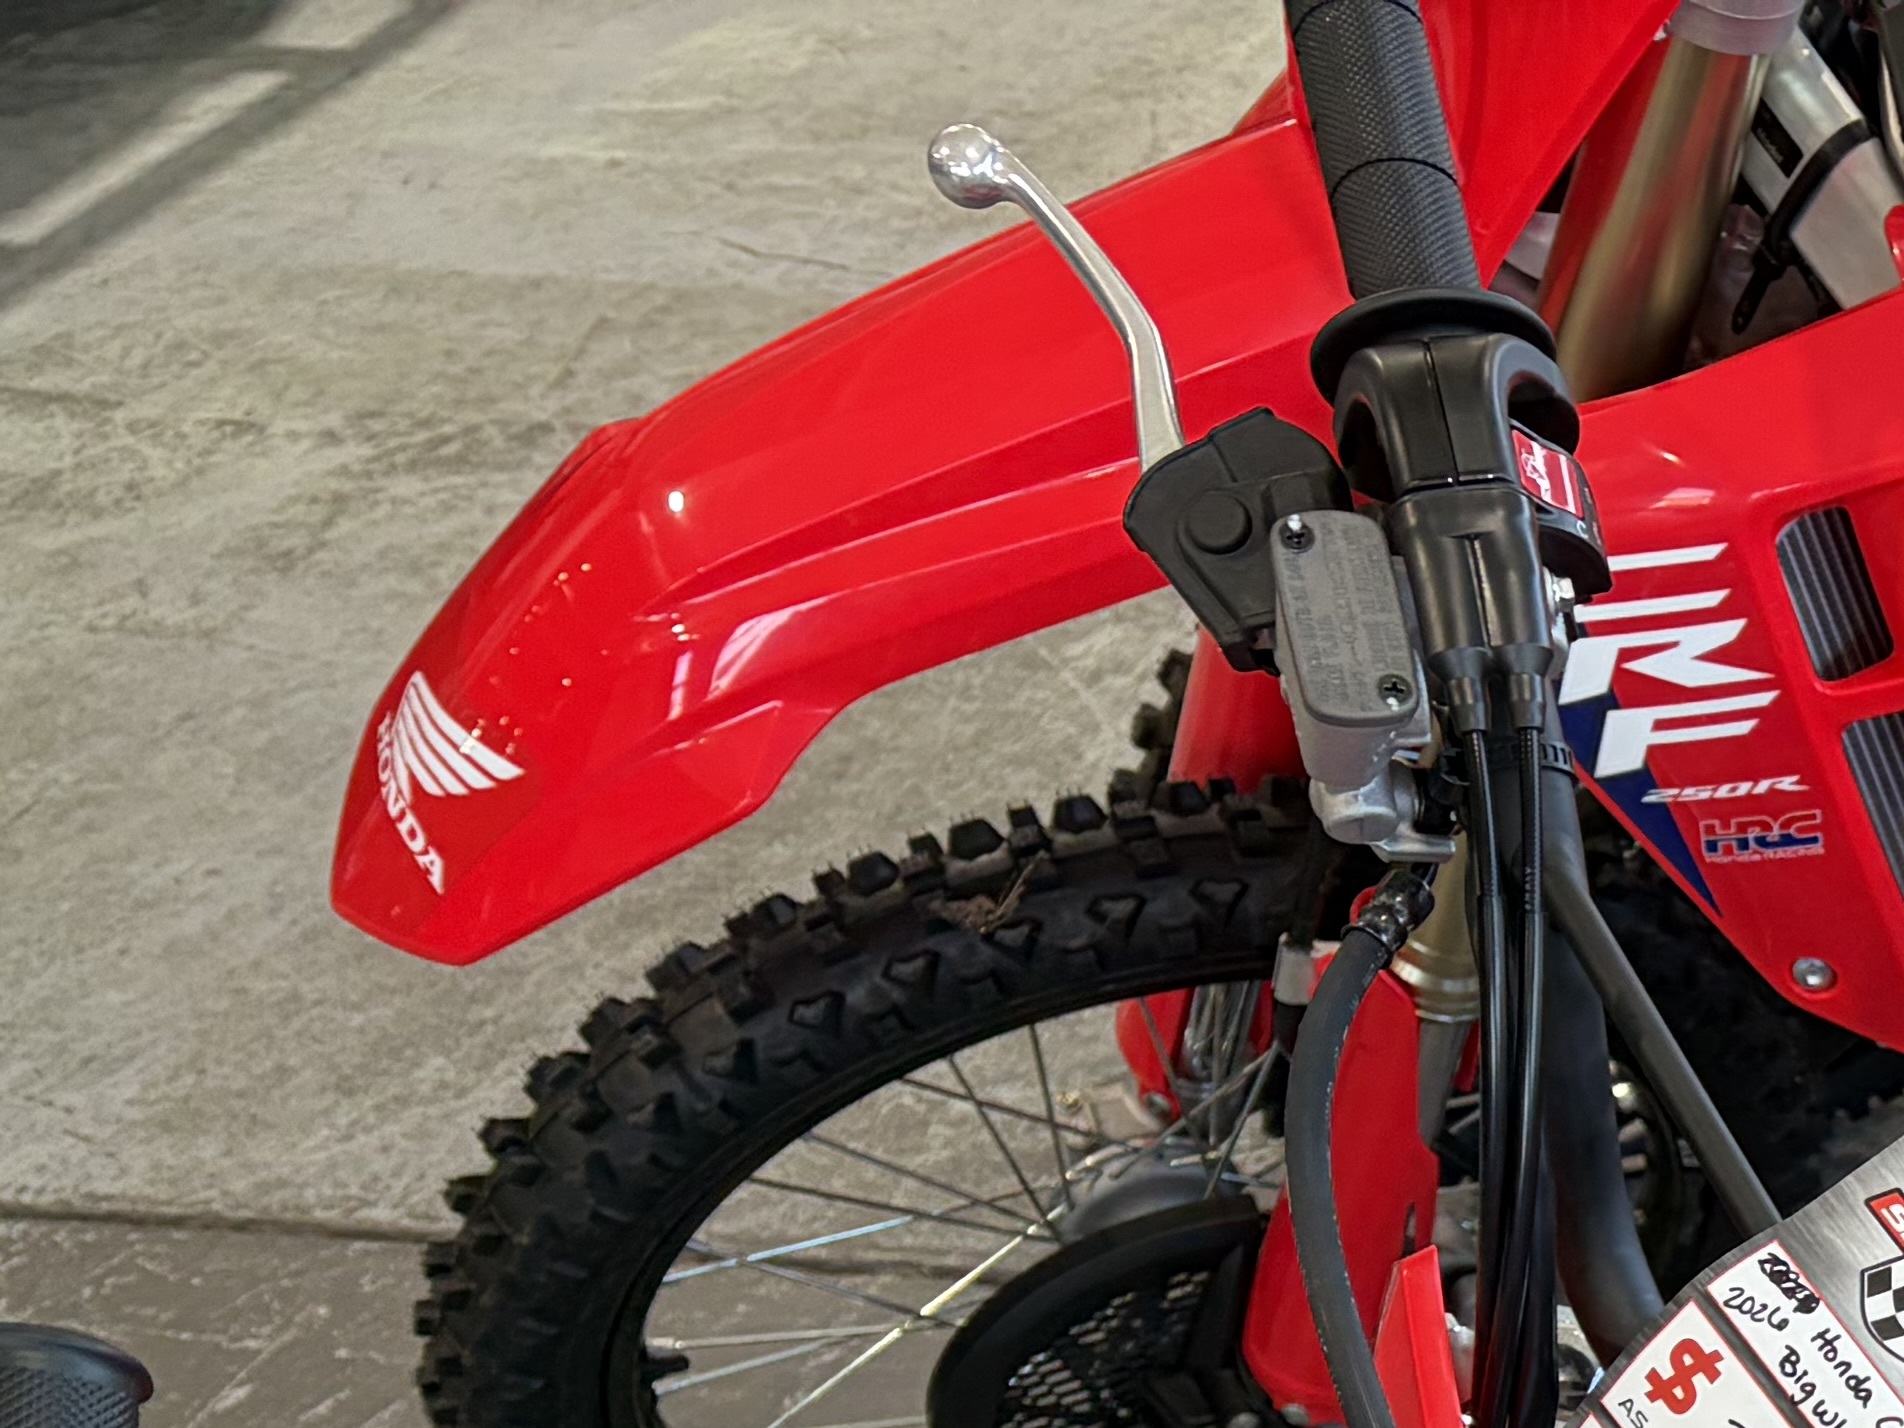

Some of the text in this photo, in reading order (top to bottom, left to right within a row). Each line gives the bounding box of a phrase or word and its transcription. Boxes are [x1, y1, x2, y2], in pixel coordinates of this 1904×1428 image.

[378, 711, 445, 896] HONDA
[1640, 774, 1811, 803] 250R
[1700, 808, 1824, 857] HRC
[1722, 1286, 1790, 1332] 2026
[1643, 1337, 1726, 1416] $
[1810, 1327, 1874, 1409] Honda
